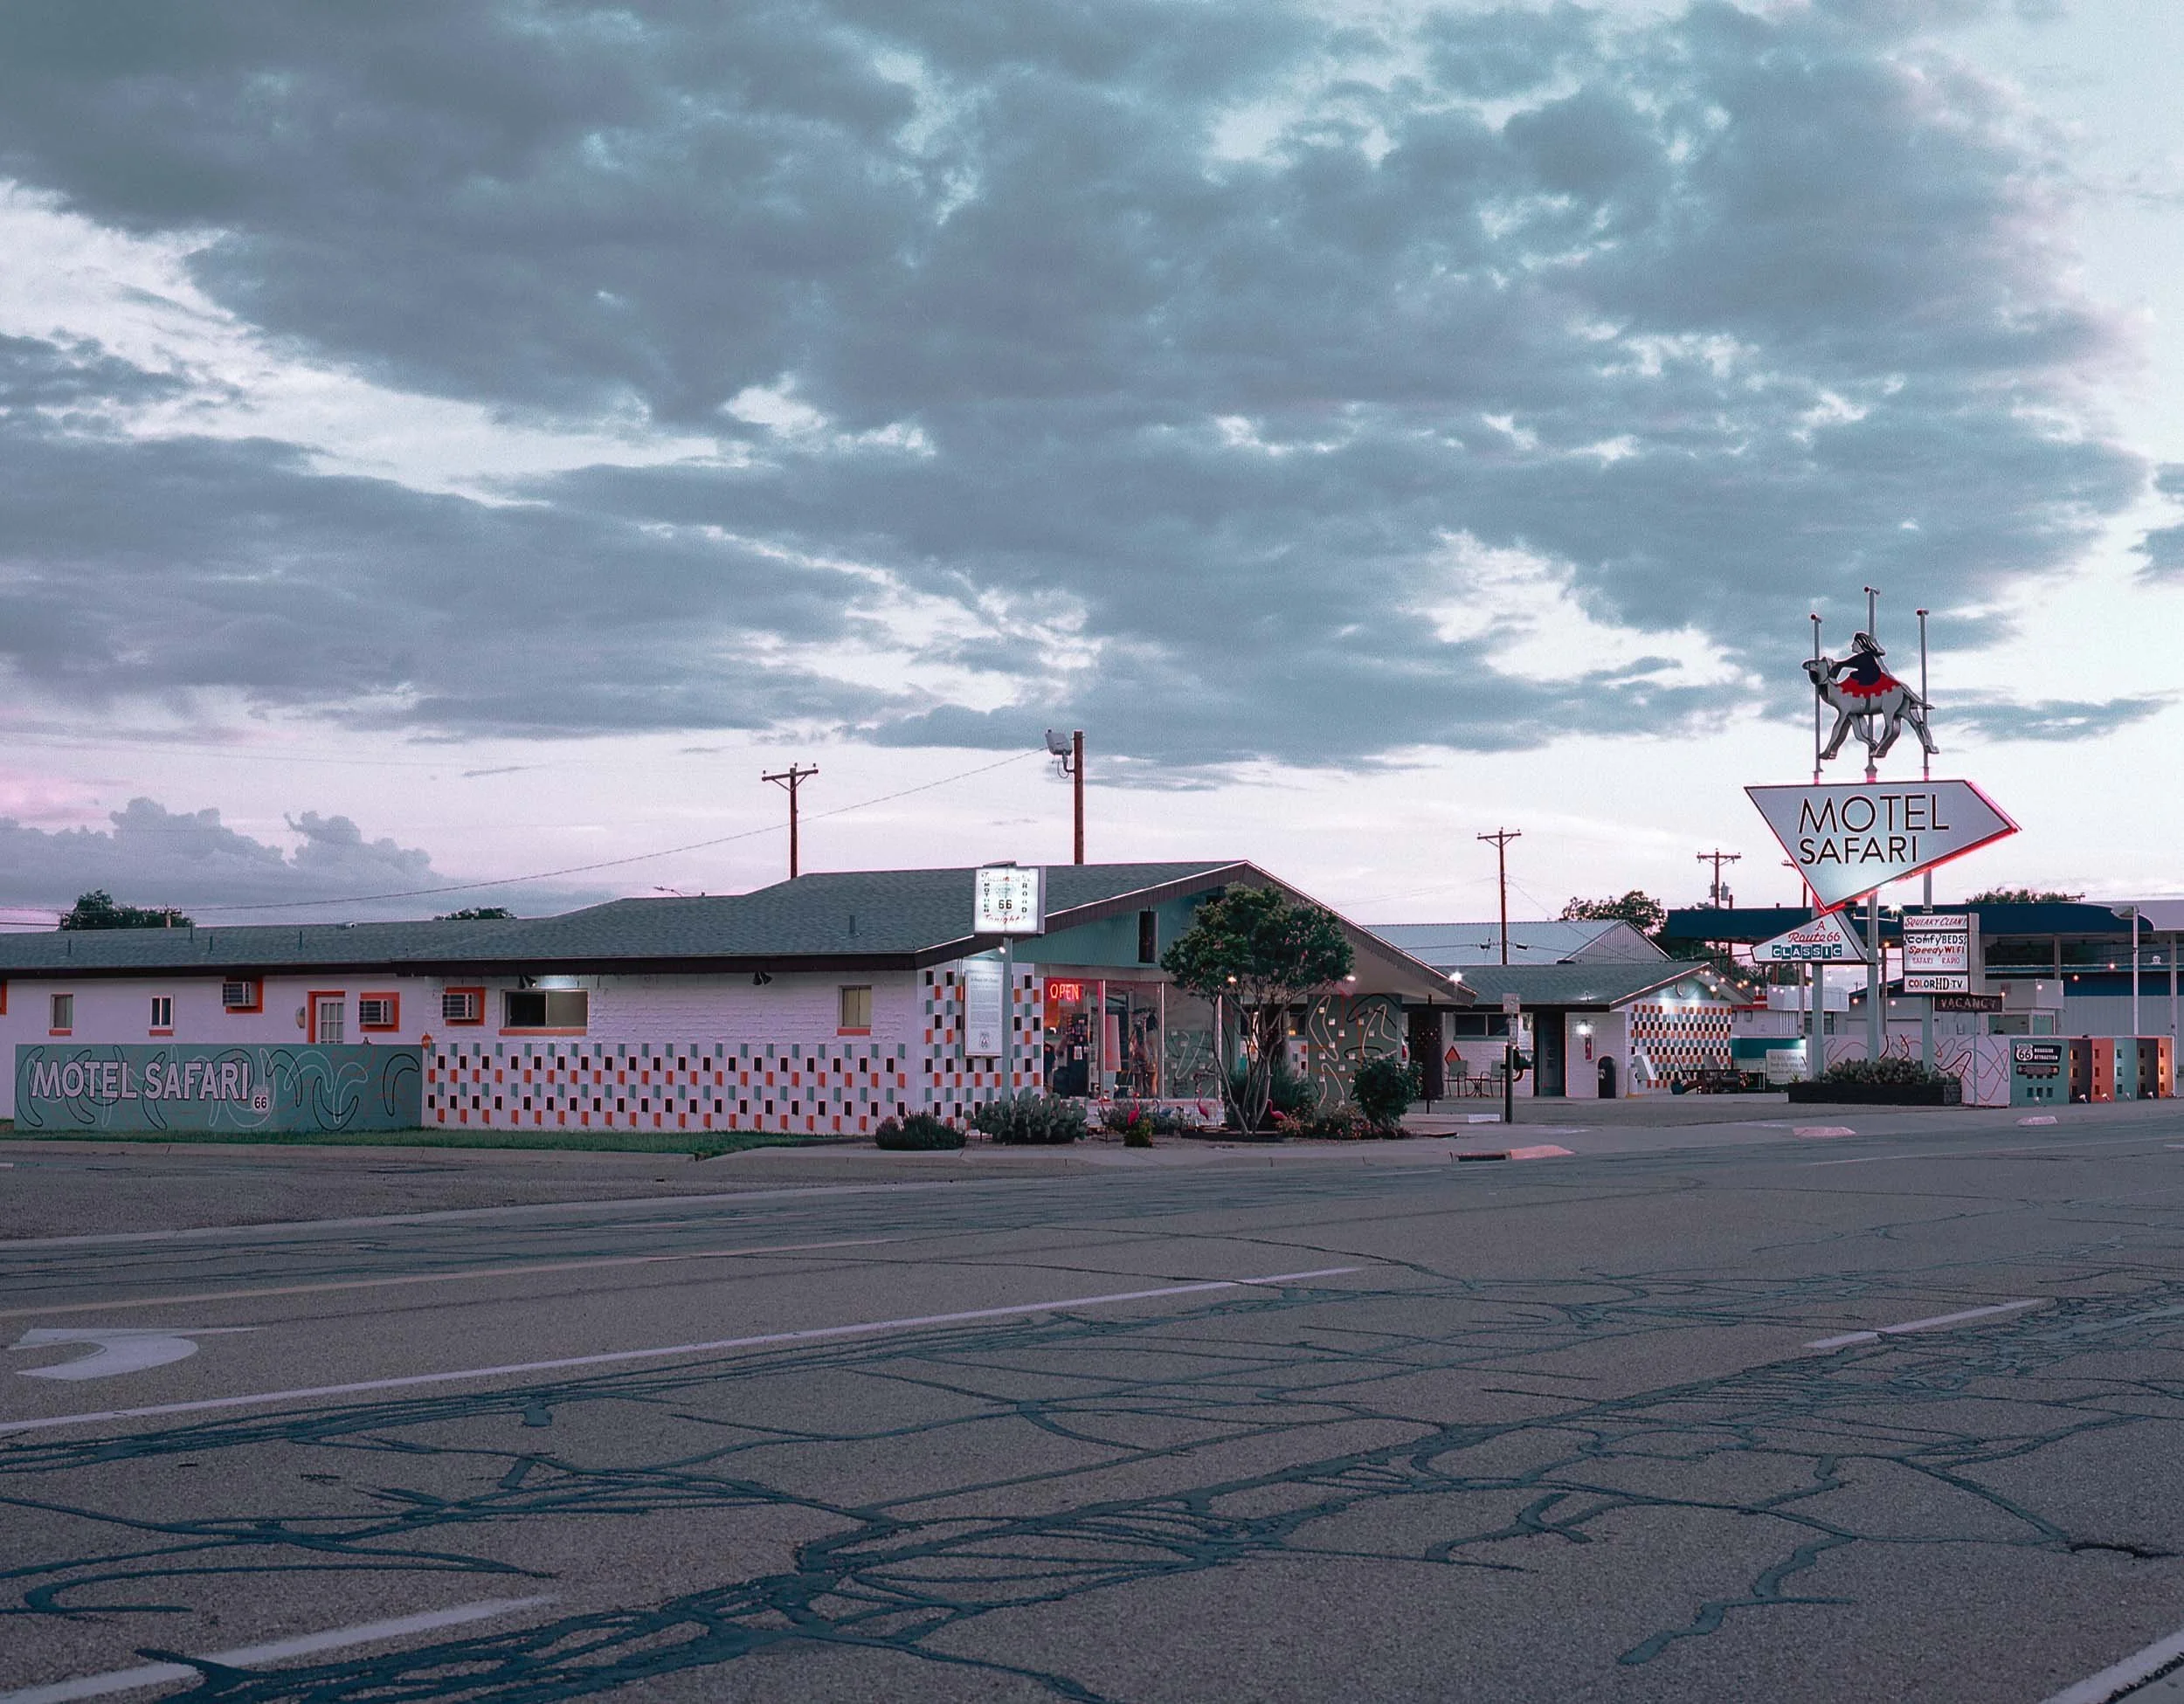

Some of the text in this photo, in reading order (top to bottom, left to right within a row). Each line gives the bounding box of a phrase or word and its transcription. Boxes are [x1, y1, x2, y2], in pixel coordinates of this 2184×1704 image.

[1799, 794, 1949, 834] MOTEL
[1800, 836, 1917, 865] SAFARI
[999, 900, 1013, 909] 66
[1815, 921, 1826, 931] A
[1788, 932, 1841, 942] Route 66
[1773, 947, 1842, 956] CLASSIC
[1908, 946, 1944, 956] Speedy
[1050, 983, 1080, 1000] OPEN
[1940, 997, 1996, 1009] VACANCY
[2018, 1049, 2031, 1059] 66
[31, 1060, 249, 1100] MOTEL SAFARI
[254, 1096, 267, 1109] 66
